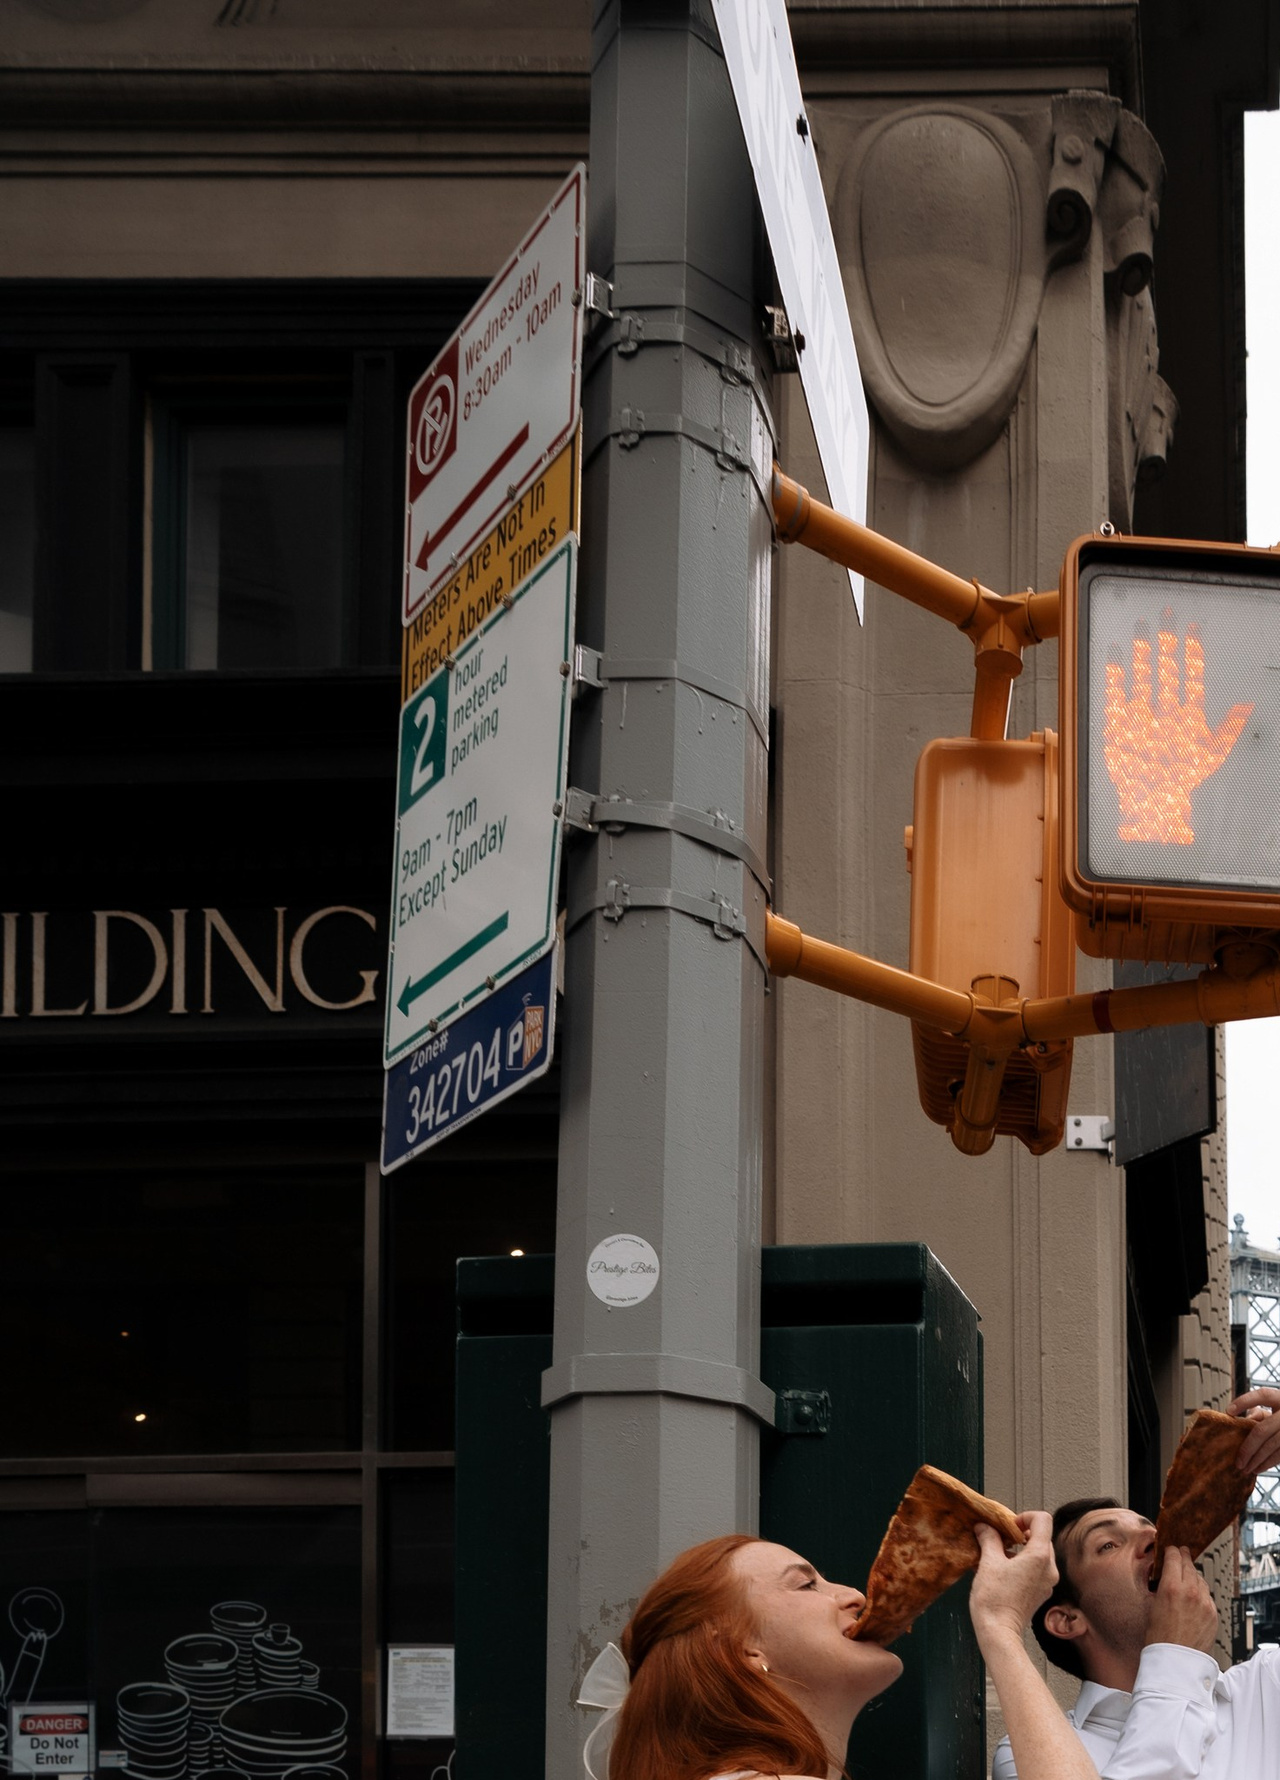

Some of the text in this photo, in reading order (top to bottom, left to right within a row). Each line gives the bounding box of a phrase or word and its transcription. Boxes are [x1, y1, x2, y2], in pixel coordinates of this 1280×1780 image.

[463, 345, 512, 422] 8:30am
[525, 281, 562, 343] 10am
[465, 262, 541, 376] Wednesday
[413, 481, 545, 650] Meters Are Not In
[412, 624, 452, 692] Effect
[457, 577, 503, 647] Above
[509, 517, 556, 589] Times
[409, 648, 483, 797] 2 hour
[453, 656, 508, 733] metered
[451, 706, 500, 775] parking
[399, 815, 508, 928] Except Sunday
[401, 837, 432, 884] 9am
[446, 796, 478, 843] 7pm
[409, 1030, 450, 1076] Zone#
[523, 1027, 542, 1062] NYC
[525, 1008, 543, 1032] PARK
[406, 1026, 501, 1145] 342704
[590, 1260, 657, 1278] Prestige Bites
[26, 1718, 83, 1731] DANGER
[30, 1737, 79, 1749] Do Not
[35, 1753, 74, 1765] Enter
